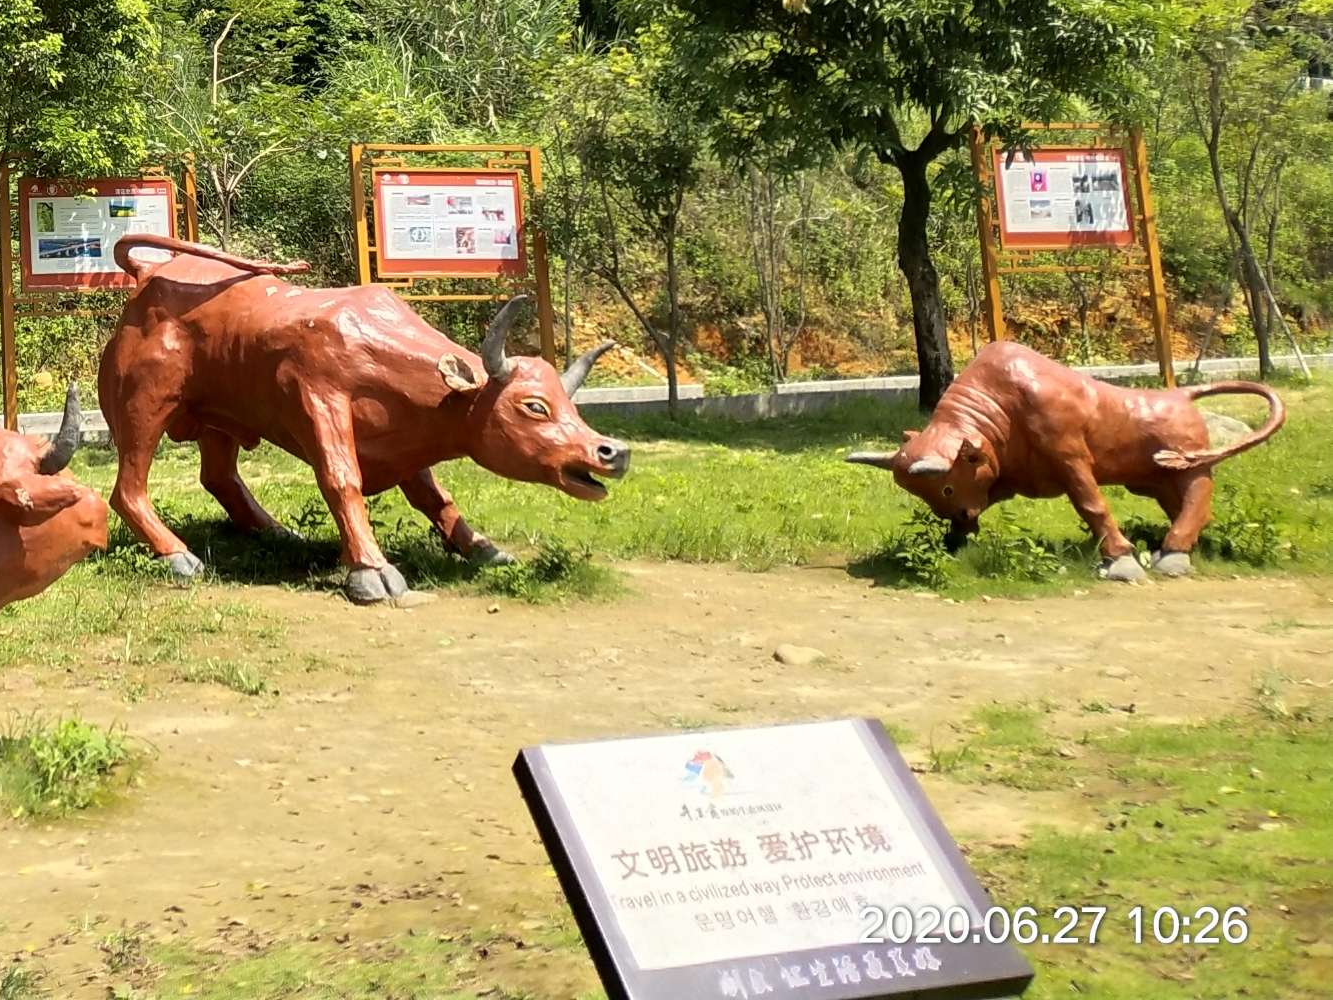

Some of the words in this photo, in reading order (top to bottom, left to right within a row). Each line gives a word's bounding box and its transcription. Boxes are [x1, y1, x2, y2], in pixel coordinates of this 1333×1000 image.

[610, 837, 748, 879] 文明旅游
[756, 824, 892, 864] 爱护环境
[660, 888, 675, 906] in
[677, 891, 687, 904] a
[689, 880, 750, 903] civilized
[839, 861, 926, 885] environment
